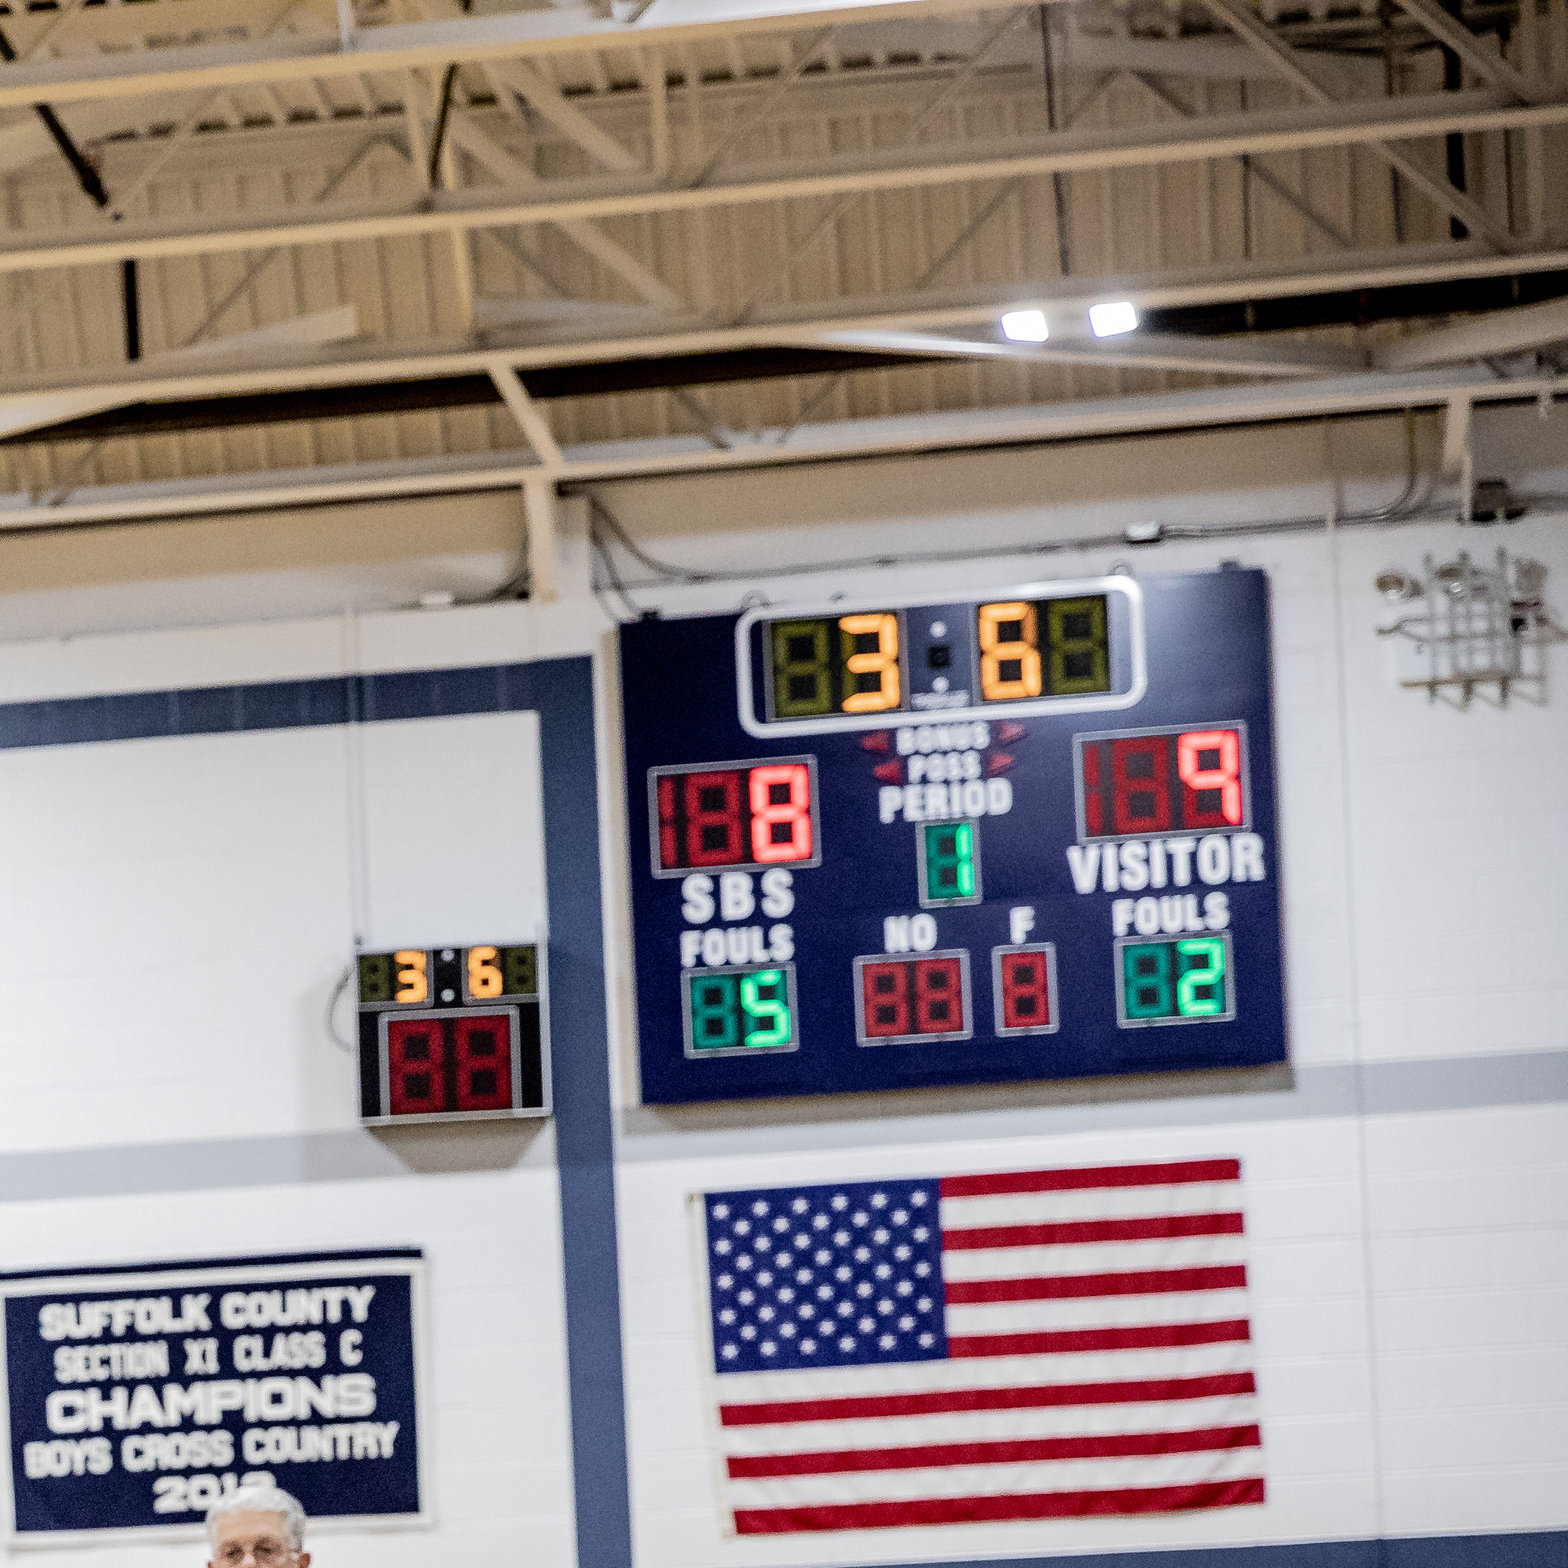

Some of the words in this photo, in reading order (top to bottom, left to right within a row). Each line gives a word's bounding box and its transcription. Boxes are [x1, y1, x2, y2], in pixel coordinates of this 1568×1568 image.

[896, 721, 991, 755] BONUS
[908, 750, 982, 783] POSS
[879, 777, 1013, 823] PERIOD
[1067, 833, 1266, 894] VISITOR
[681, 868, 795, 924] SBS
[1112, 891, 1230, 937] FOULS
[680, 923, 795, 967] FOULS
[884, 913, 937, 953] NO
[1010, 906, 1035, 943] F
[38, 1292, 213, 1341] SUFFOLK
[220, 1286, 376, 1330] COUNTY
[55, 1341, 170, 1383] SECTION
[185, 1337, 220, 1375] XI
[233, 1330, 327, 1371] CLASS
[340, 1329, 363, 1367] C
[46, 1373, 377, 1433] CHAMPIONS
[23, 1436, 112, 1478] BOYS
[122, 1430, 235, 1472] CROSS
[242, 1421, 399, 1463] COUNTRY
